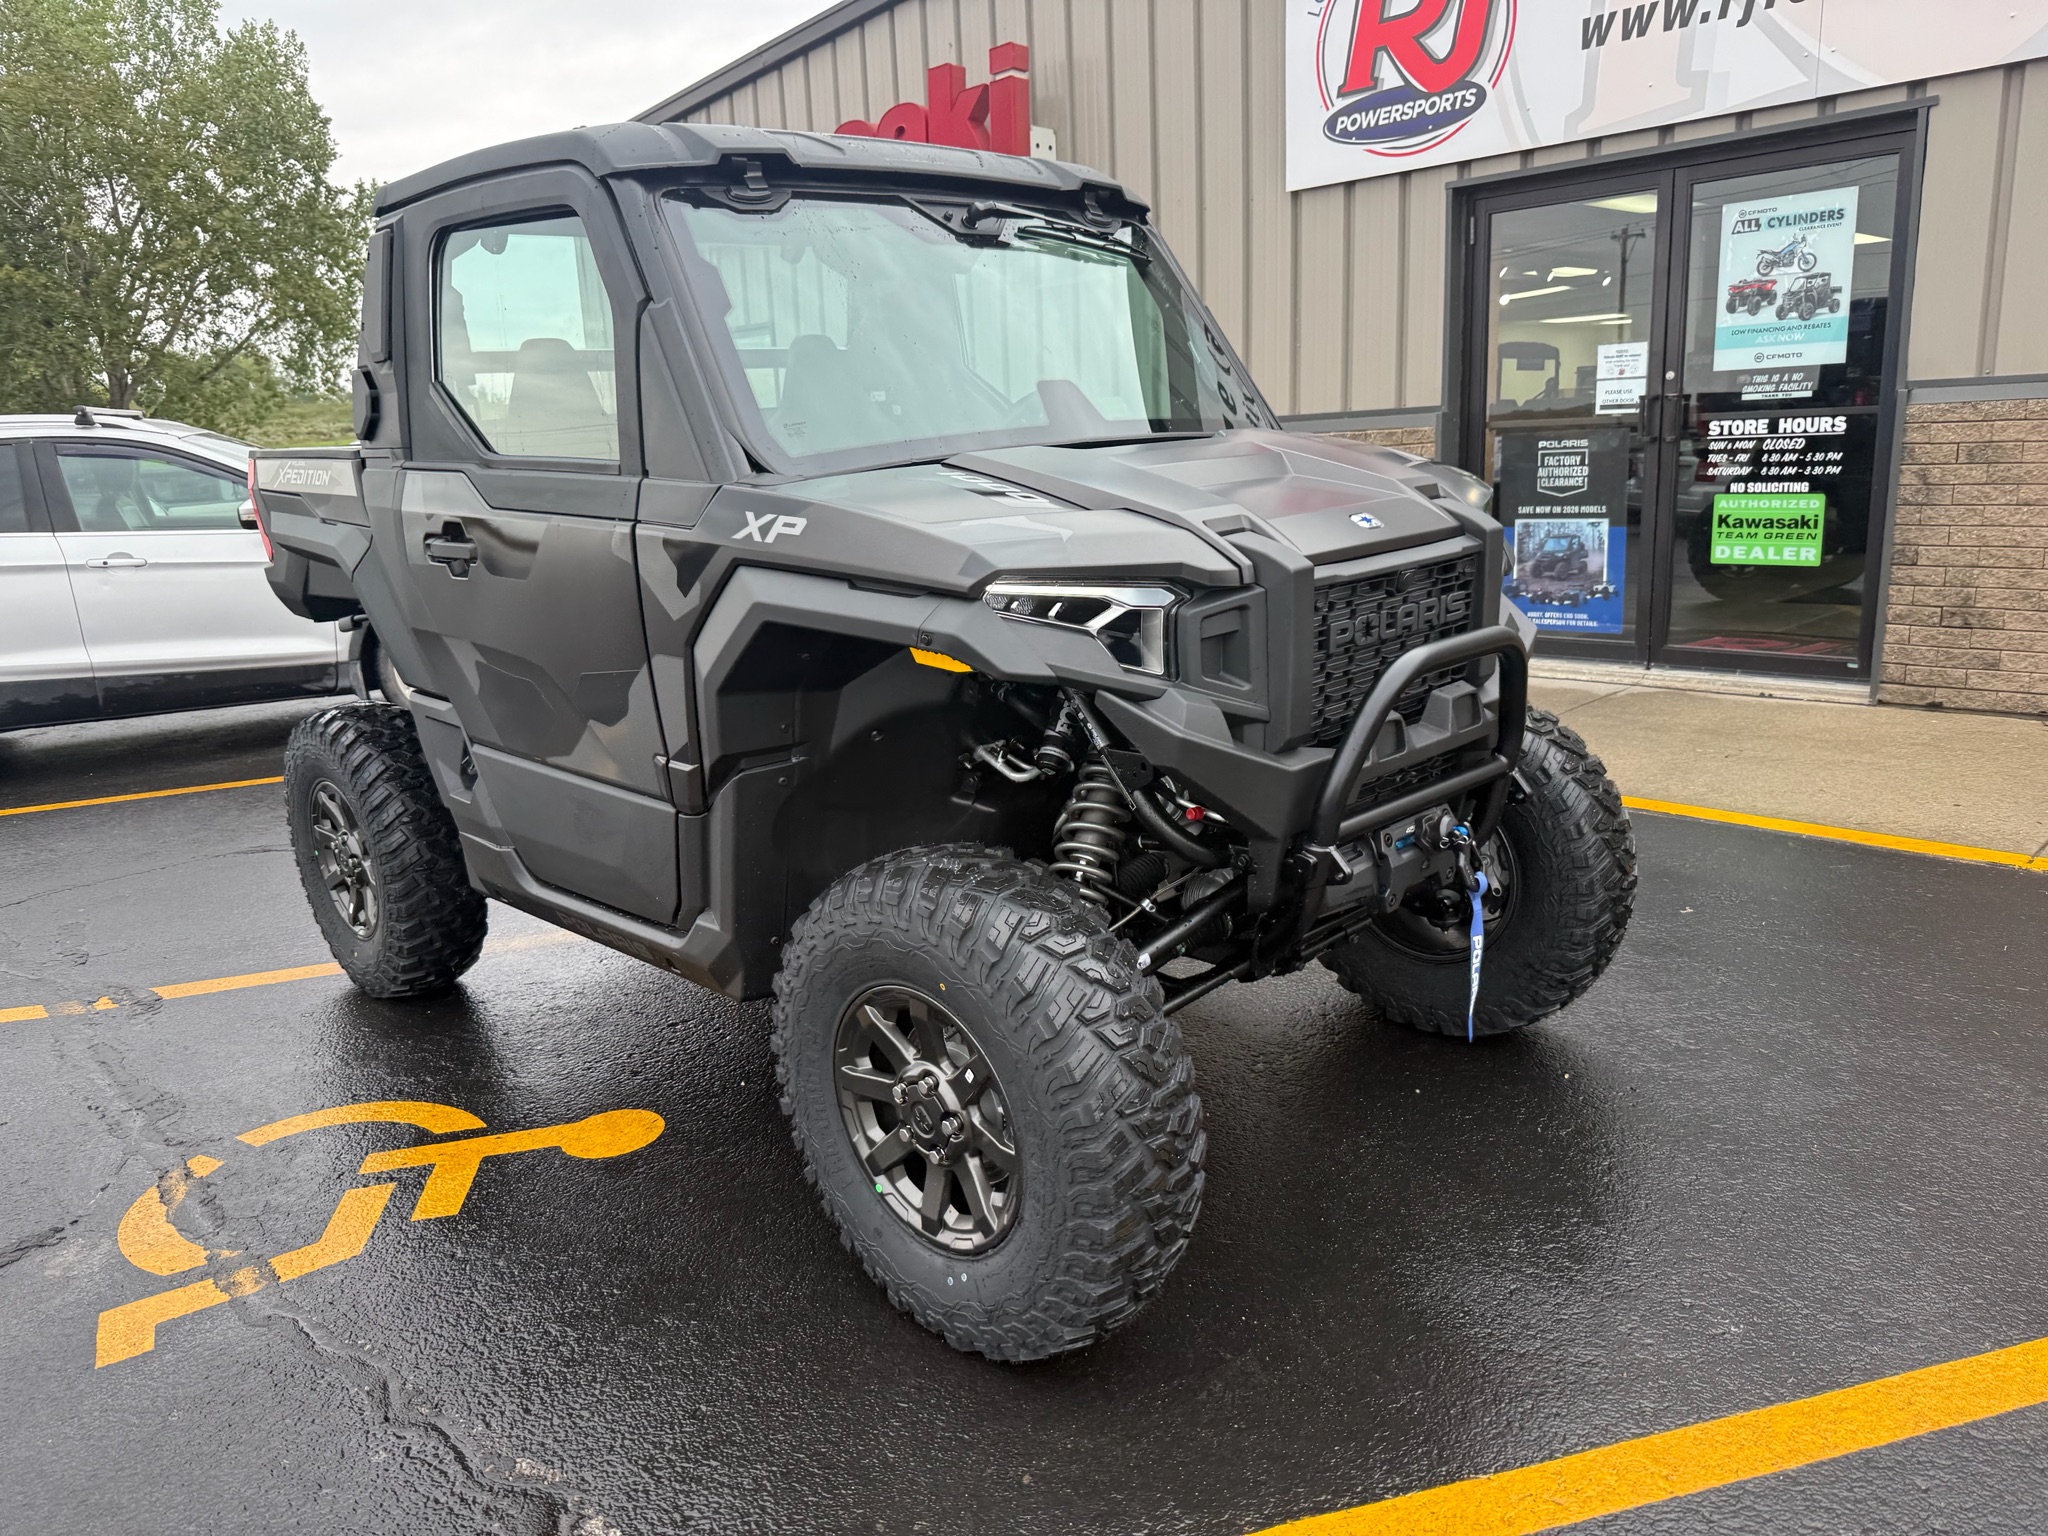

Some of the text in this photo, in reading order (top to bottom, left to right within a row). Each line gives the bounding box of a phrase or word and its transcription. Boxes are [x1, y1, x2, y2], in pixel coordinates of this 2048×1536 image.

[1335, 87, 1477, 135] POWERSPORTS
[1748, 207, 1778, 216] CFMOTO
[1734, 208, 1845, 234] ALL CYLINDERS
[1799, 221, 1843, 231] CLEARANCE EVENT
[1747, 326, 1786, 334] FINANCING
[1803, 322, 1831, 330] REBATES
[1755, 332, 1805, 344] ASK NOW
[1766, 352, 1803, 360] CFMOTO
[1752, 374, 1769, 384] THIS
[1771, 374, 1781, 383] IS
[1782, 373, 1788, 382] A
[1791, 372, 1804, 381] NO
[1741, 381, 1813, 394] SMOKING FACILITY
[1707, 416, 1847, 436] STORE HOURS
[1538, 439, 1589, 449] POLARIS
[1707, 440, 1728, 450] SUN
[1733, 440, 1756, 449] MON
[1762, 437, 1806, 450] CLOSED
[1544, 455, 1582, 466] FACTORY
[1707, 453, 1728, 463] TUES
[1734, 453, 1750, 462] FRI
[1780, 452, 1799, 462] AM
[1825, 452, 1843, 460] PM
[274, 461, 332, 488] XPEDITION
[1537, 466, 1589, 477] AUTHORIZED
[1706, 466, 1752, 476] SATURDAY
[1779, 466, 1798, 475] AM
[1824, 465, 1842, 475] PM
[1541, 476, 1584, 487] CLEARANCE
[1730, 482, 1810, 493] NO SOLICITING
[1518, 505, 1534, 514] SAVE
[1535, 505, 1552, 514] NOW
[1552, 505, 1562, 514] ON
[1580, 505, 1607, 514] MODELS
[1718, 499, 1820, 509] AUTHORIZED
[1717, 513, 1819, 530] Kawasaki
[731, 511, 808, 544] XP
[1763, 532, 1818, 540] GREEN
[1715, 546, 1817, 561] DEALER
[1329, 591, 1466, 654] POLARIS
